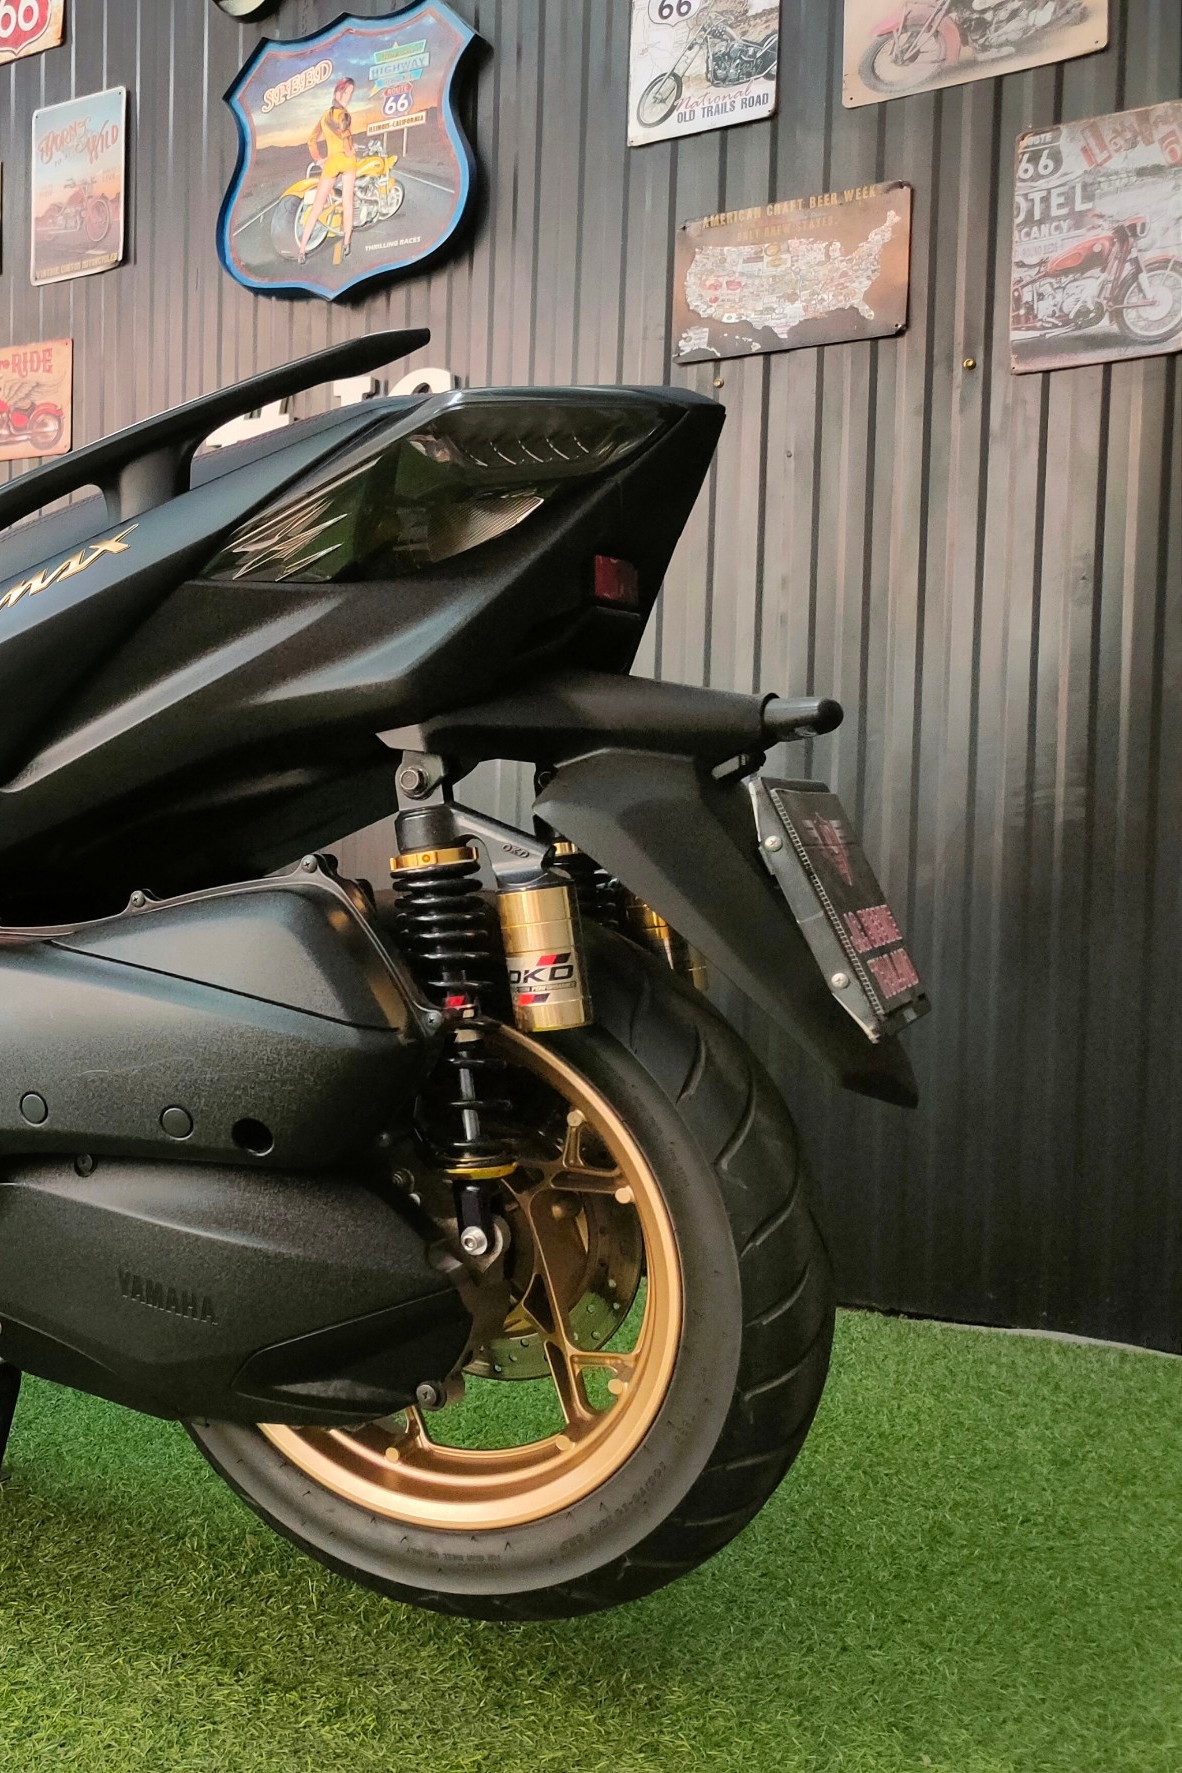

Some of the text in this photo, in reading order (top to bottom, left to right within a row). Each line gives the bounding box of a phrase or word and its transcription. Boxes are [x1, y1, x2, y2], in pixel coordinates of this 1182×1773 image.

[658, 0, 691, 20] 66
[372, 56, 425, 77] HIGHWAY
[262, 60, 332, 112] SPEED
[676, 78, 753, 111] National
[385, 94, 408, 114] 66
[677, 93, 769, 123] OLD TRAILS ROAD
[1018, 149, 1054, 179] 66
[703, 207, 761, 228] AMERICAN
[767, 199, 803, 216] CRAFT
[810, 193, 838, 208] BEER
[844, 185, 876, 201] WEEK
[365, 236, 421, 251] THRILLING RACES
[11, 348, 53, 378] RIDE
[119, 1267, 218, 1326] YAMAHA
